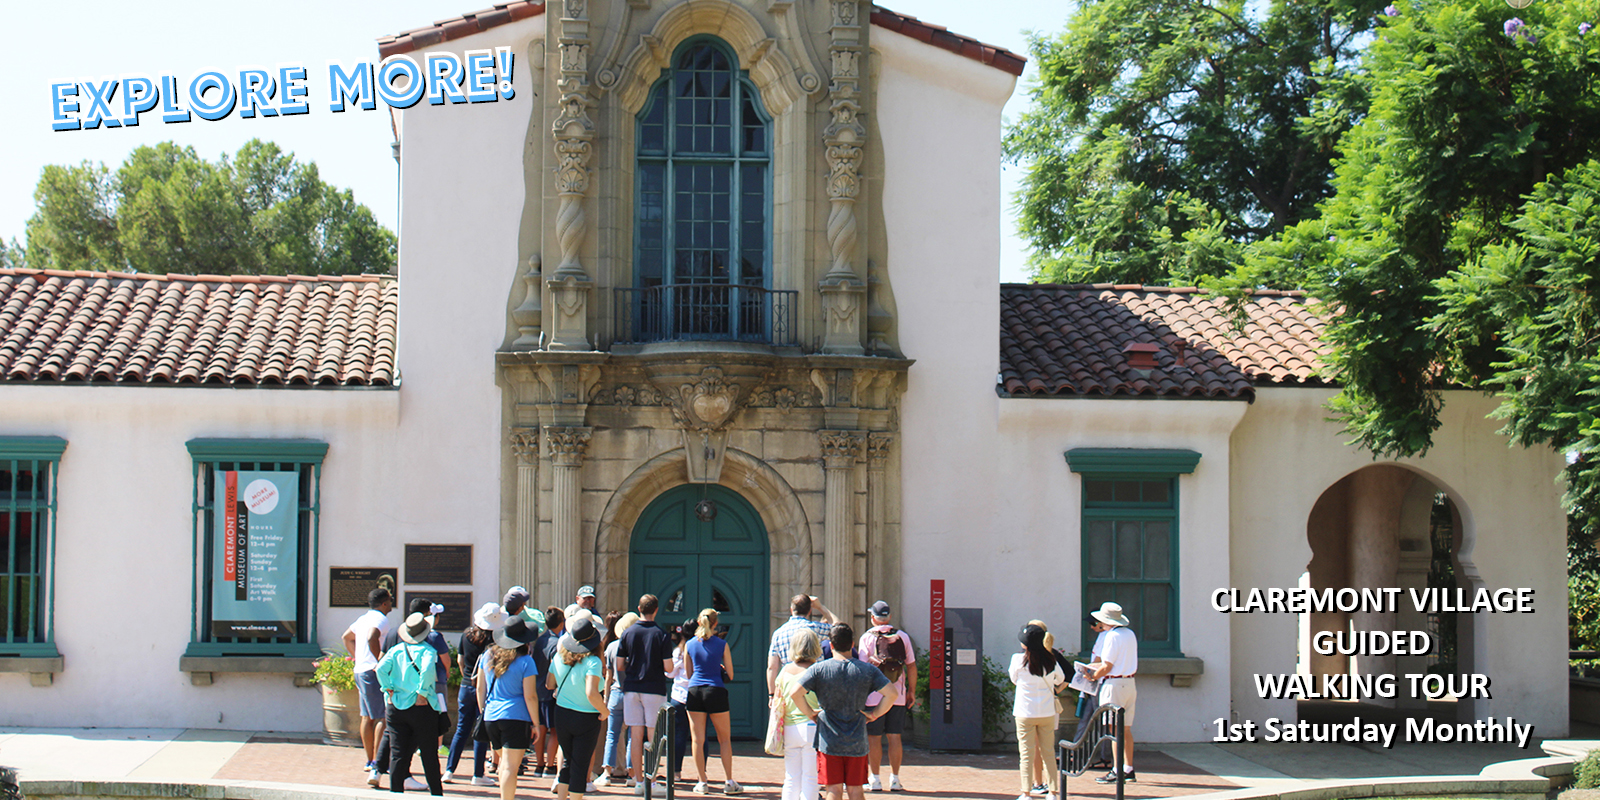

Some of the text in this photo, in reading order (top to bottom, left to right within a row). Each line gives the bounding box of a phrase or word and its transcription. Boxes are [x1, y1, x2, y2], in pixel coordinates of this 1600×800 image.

[251, 487, 268, 500] MORE
[251, 490, 276, 508] MUSEUM!
[226, 485, 235, 574] CLAREMONT LEWIS
[238, 513, 246, 589] MUSEUM OF ART
[932, 590, 943, 680] CLAREMONT
[945, 660, 951, 671] OF
